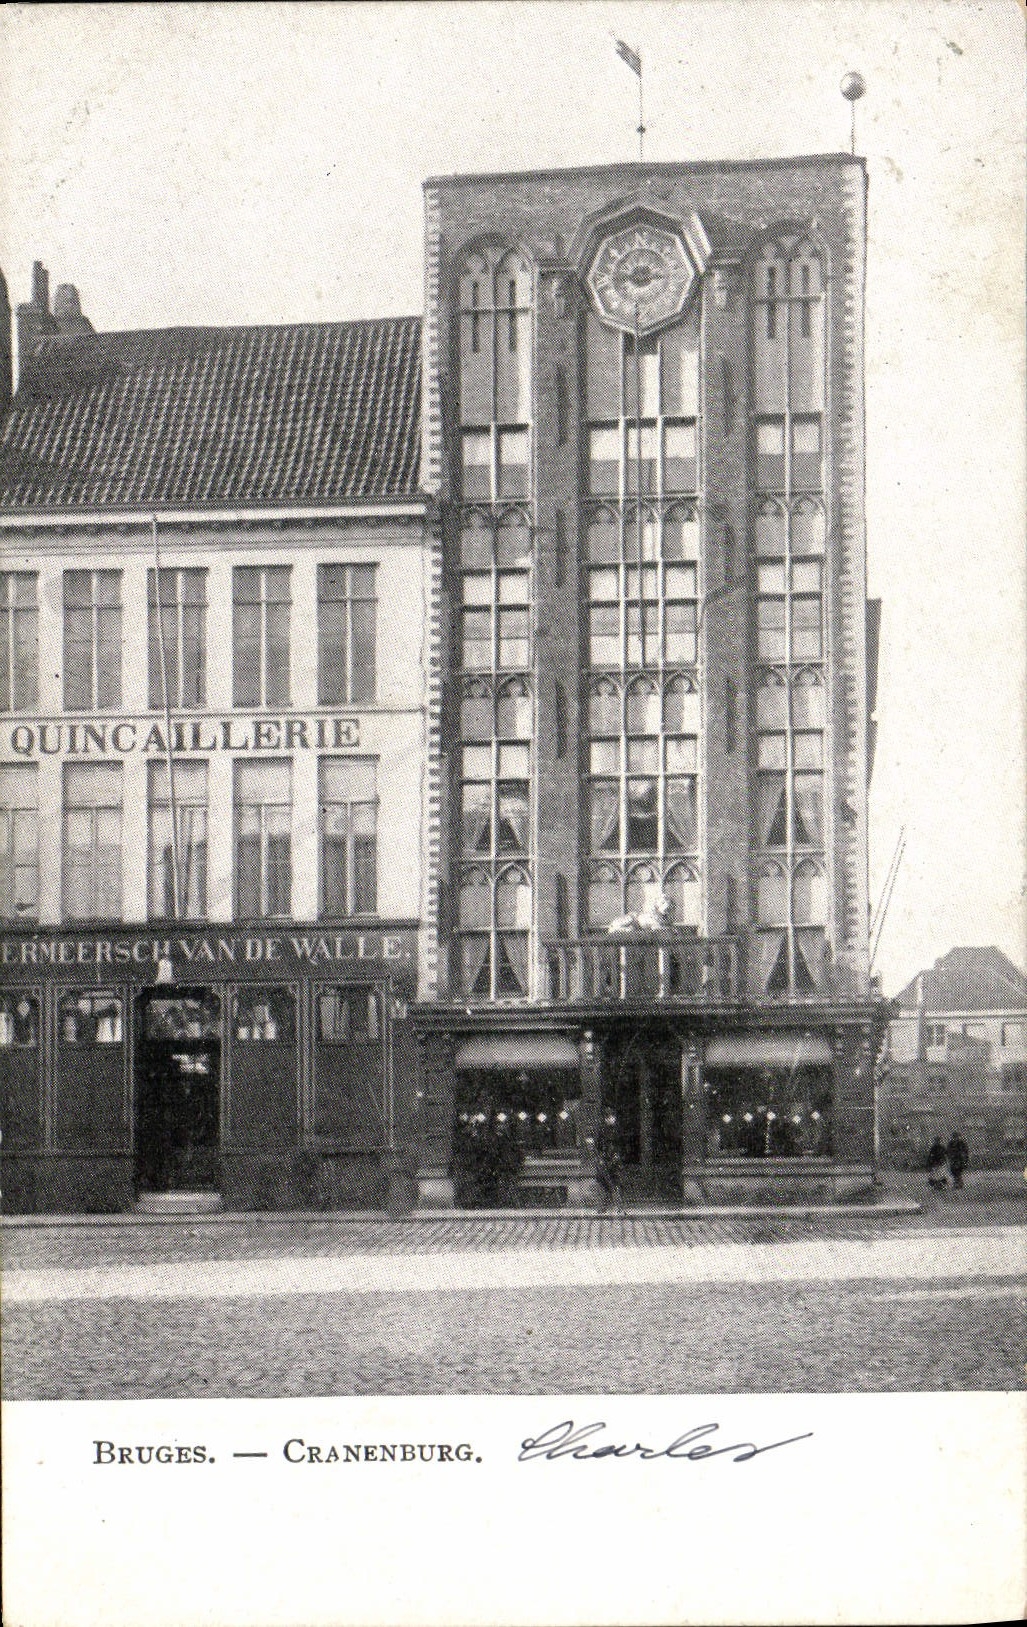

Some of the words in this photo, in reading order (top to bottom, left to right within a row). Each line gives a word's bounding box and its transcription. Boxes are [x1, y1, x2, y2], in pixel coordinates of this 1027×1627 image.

[10, 718, 361, 755] QUINCAILLERIE
[179, 937, 238, 961] VAN
[246, 937, 281, 961] DE
[518, 1420, 814, 1462] Charles
